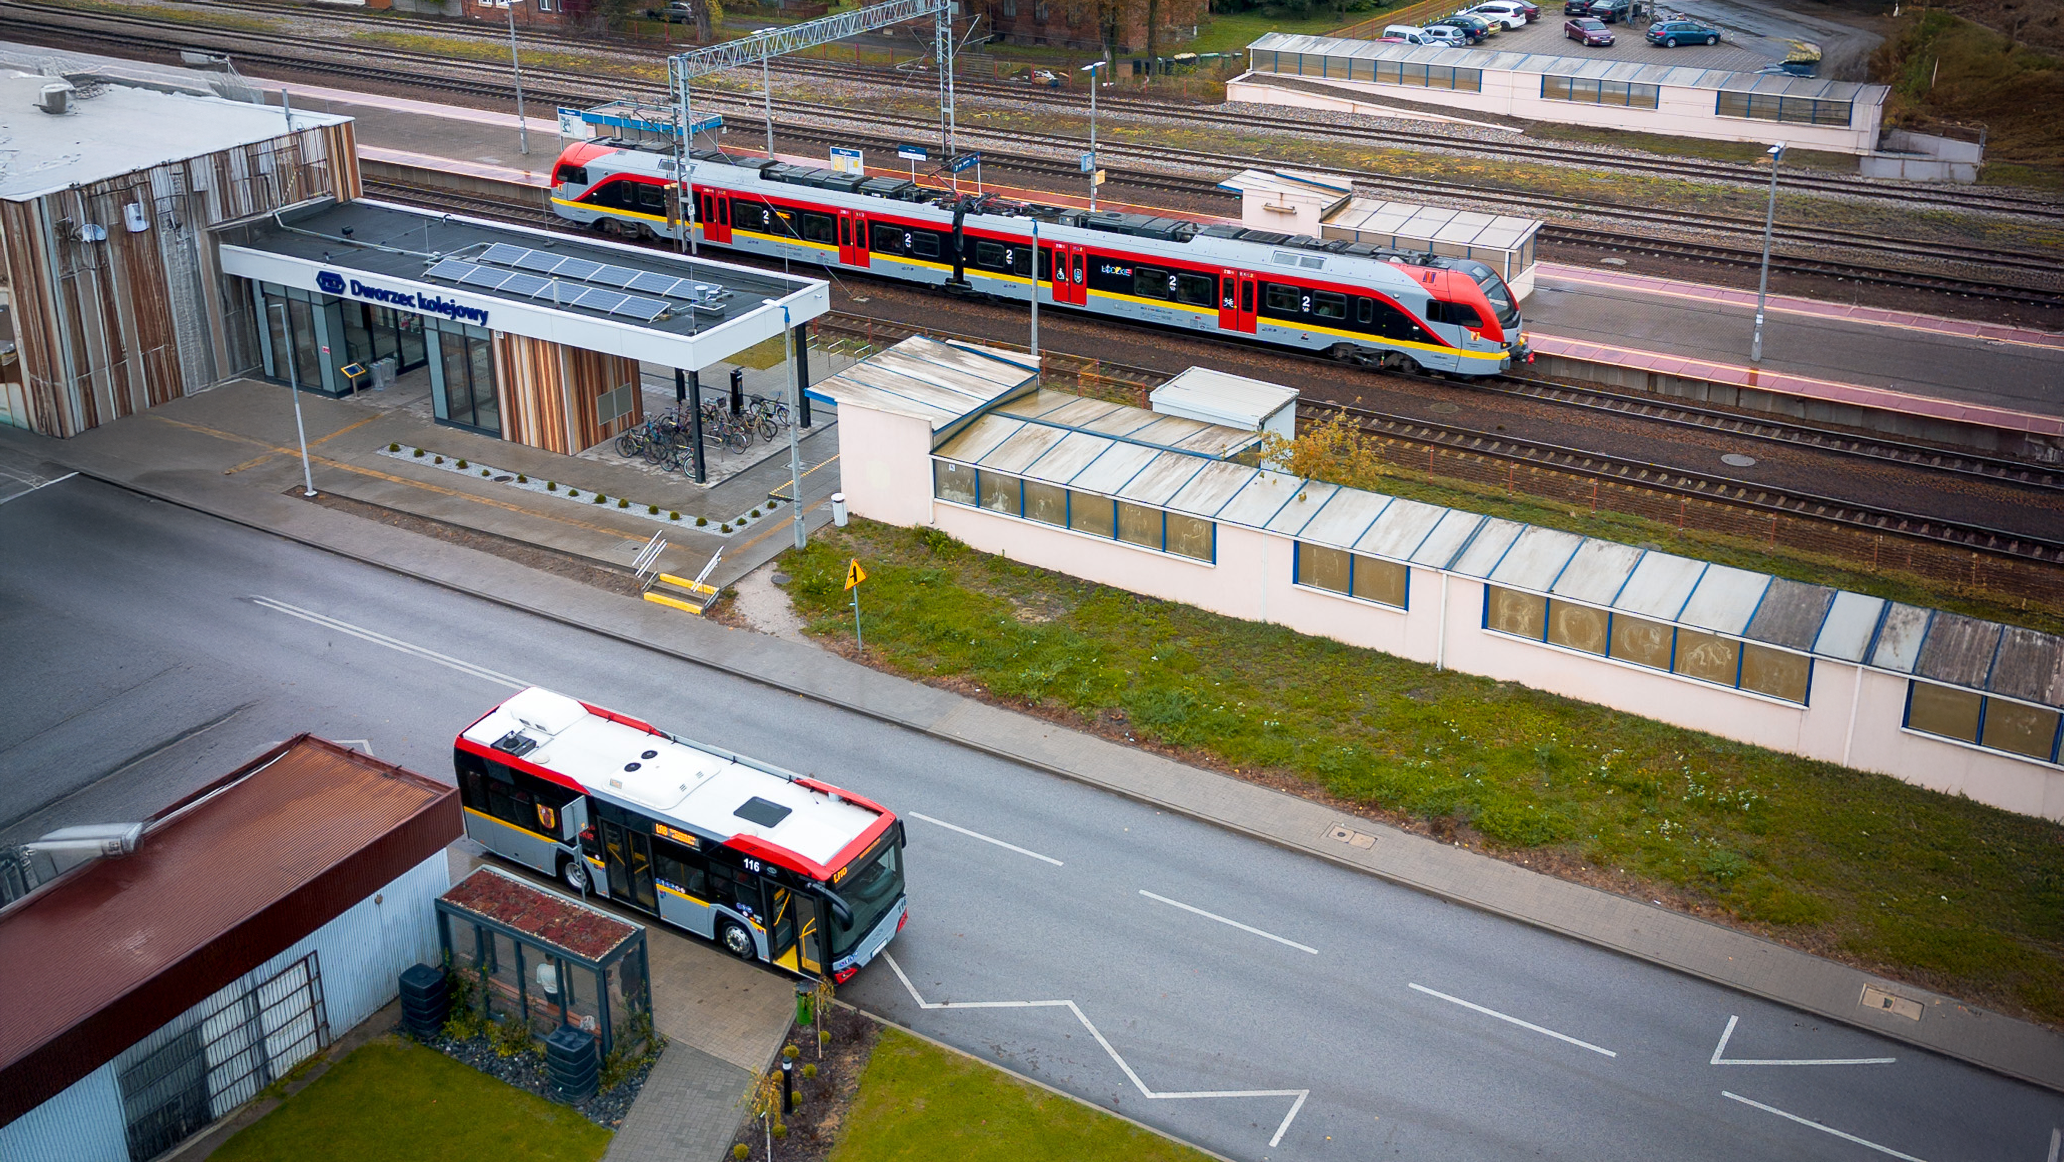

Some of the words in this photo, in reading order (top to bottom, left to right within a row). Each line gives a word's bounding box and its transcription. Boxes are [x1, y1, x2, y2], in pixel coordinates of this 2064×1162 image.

[763, 210, 769, 220] 2
[905, 233, 911, 243] 2
[1006, 249, 1013, 259] 2
[1169, 275, 1176, 286] 2
[350, 279, 416, 308] Dworzec
[417, 291, 488, 327] kolejowy
[1302, 296, 1310, 307] 2
[743, 858, 760, 873] 116
